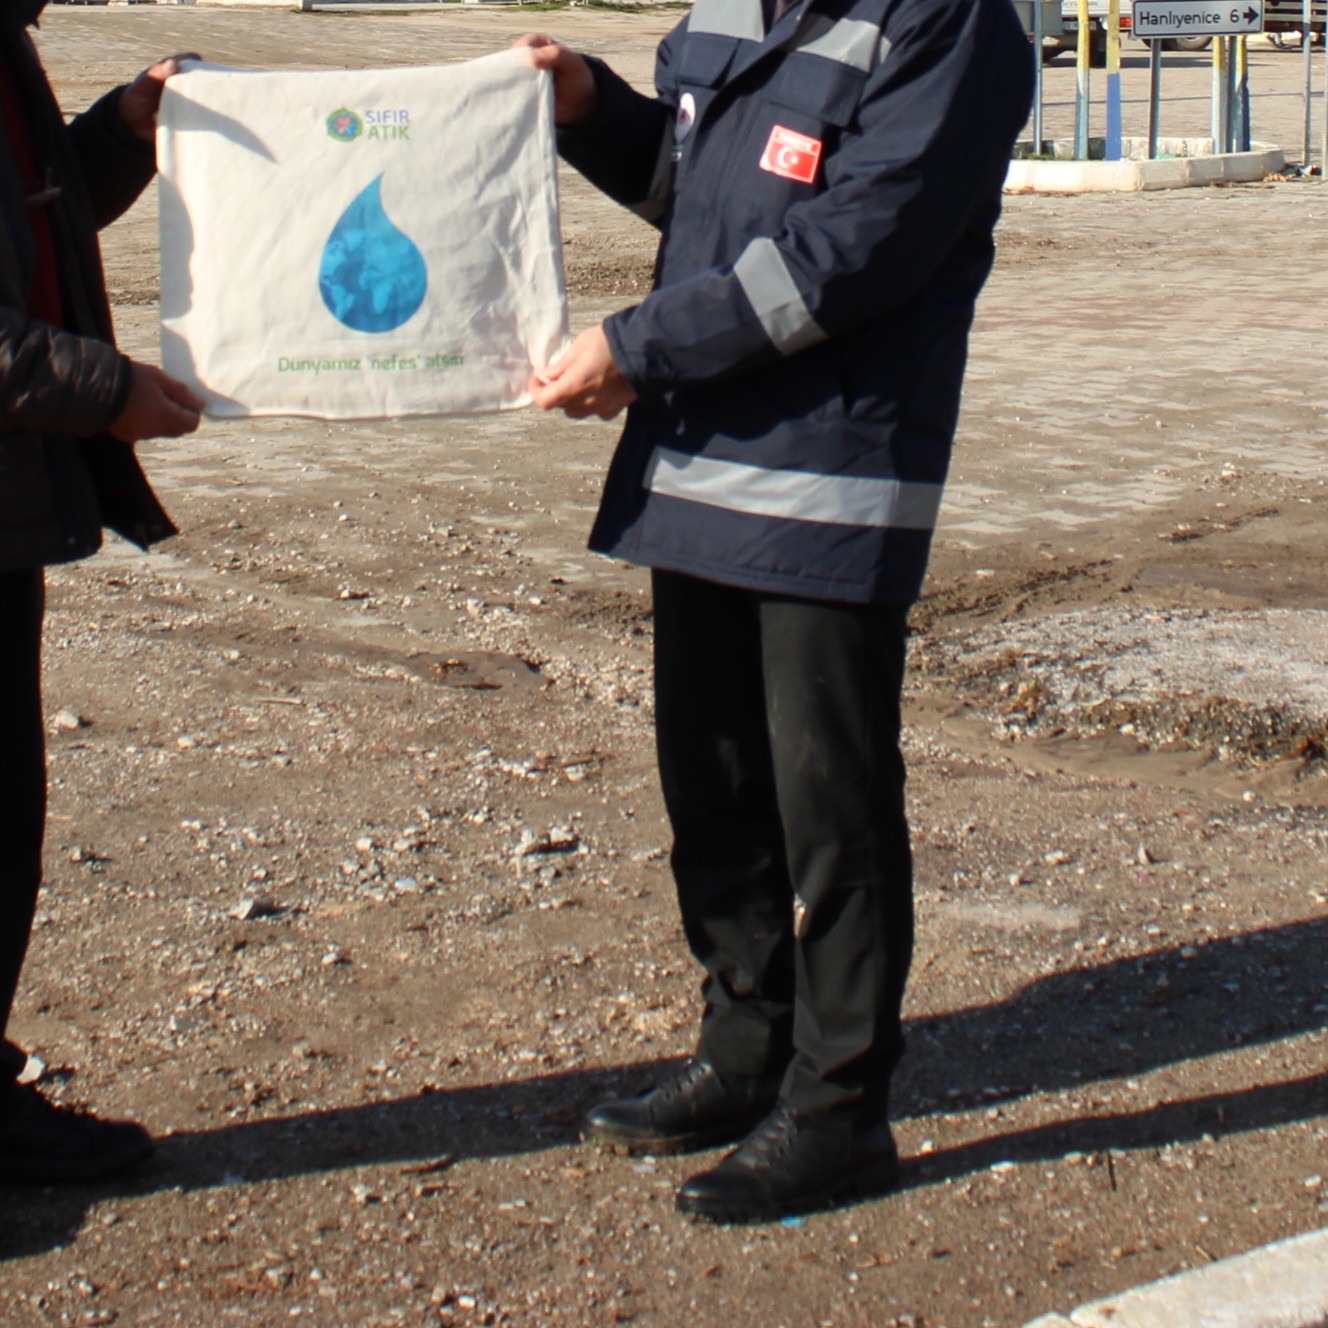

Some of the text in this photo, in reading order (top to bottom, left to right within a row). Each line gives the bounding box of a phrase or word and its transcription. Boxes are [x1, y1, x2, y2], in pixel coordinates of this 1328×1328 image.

[1139, 9, 1240, 28] Hanlıyenice 6
[366, 110, 409, 124] SIFIR
[368, 125, 410, 140] ATIK
